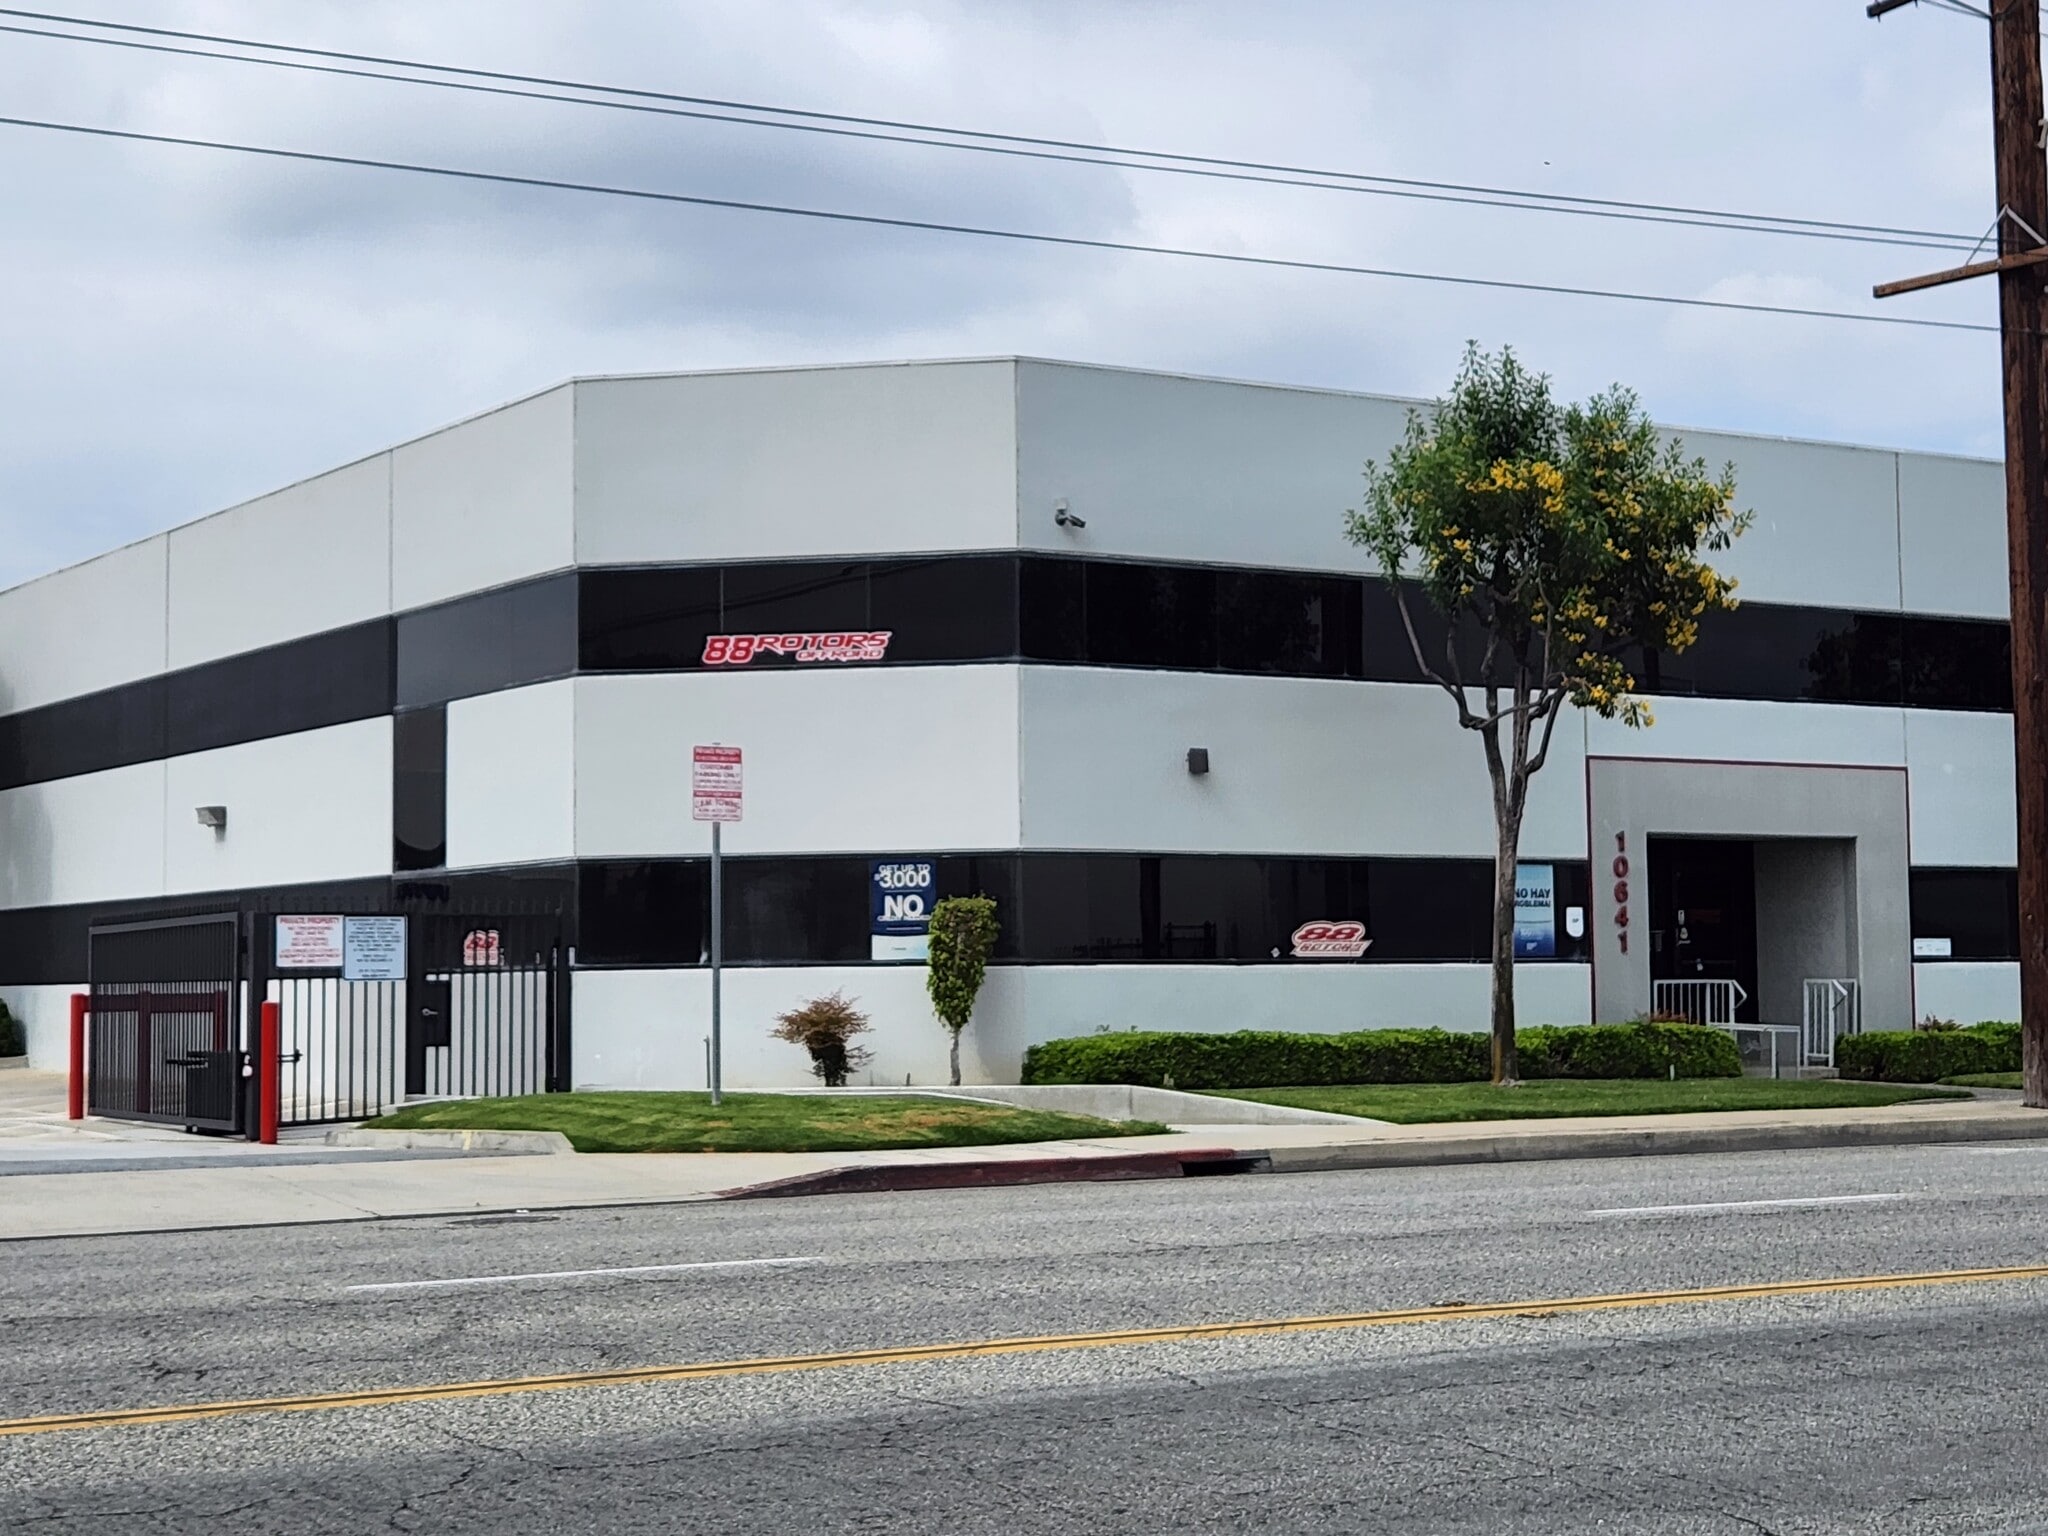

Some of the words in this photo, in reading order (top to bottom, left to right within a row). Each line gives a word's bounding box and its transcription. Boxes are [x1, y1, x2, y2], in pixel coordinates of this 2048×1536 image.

[702, 635, 756, 664] 88
[755, 632, 892, 655] ROTORS
[879, 865, 899, 873] GET
[901, 864, 915, 872] UP
[916, 864, 931, 872] TO
[1530, 888, 1551, 898] HAY
[1613, 830, 1629, 955] 10641
[884, 894, 924, 919] NO
[1297, 926, 1360, 940] 88
